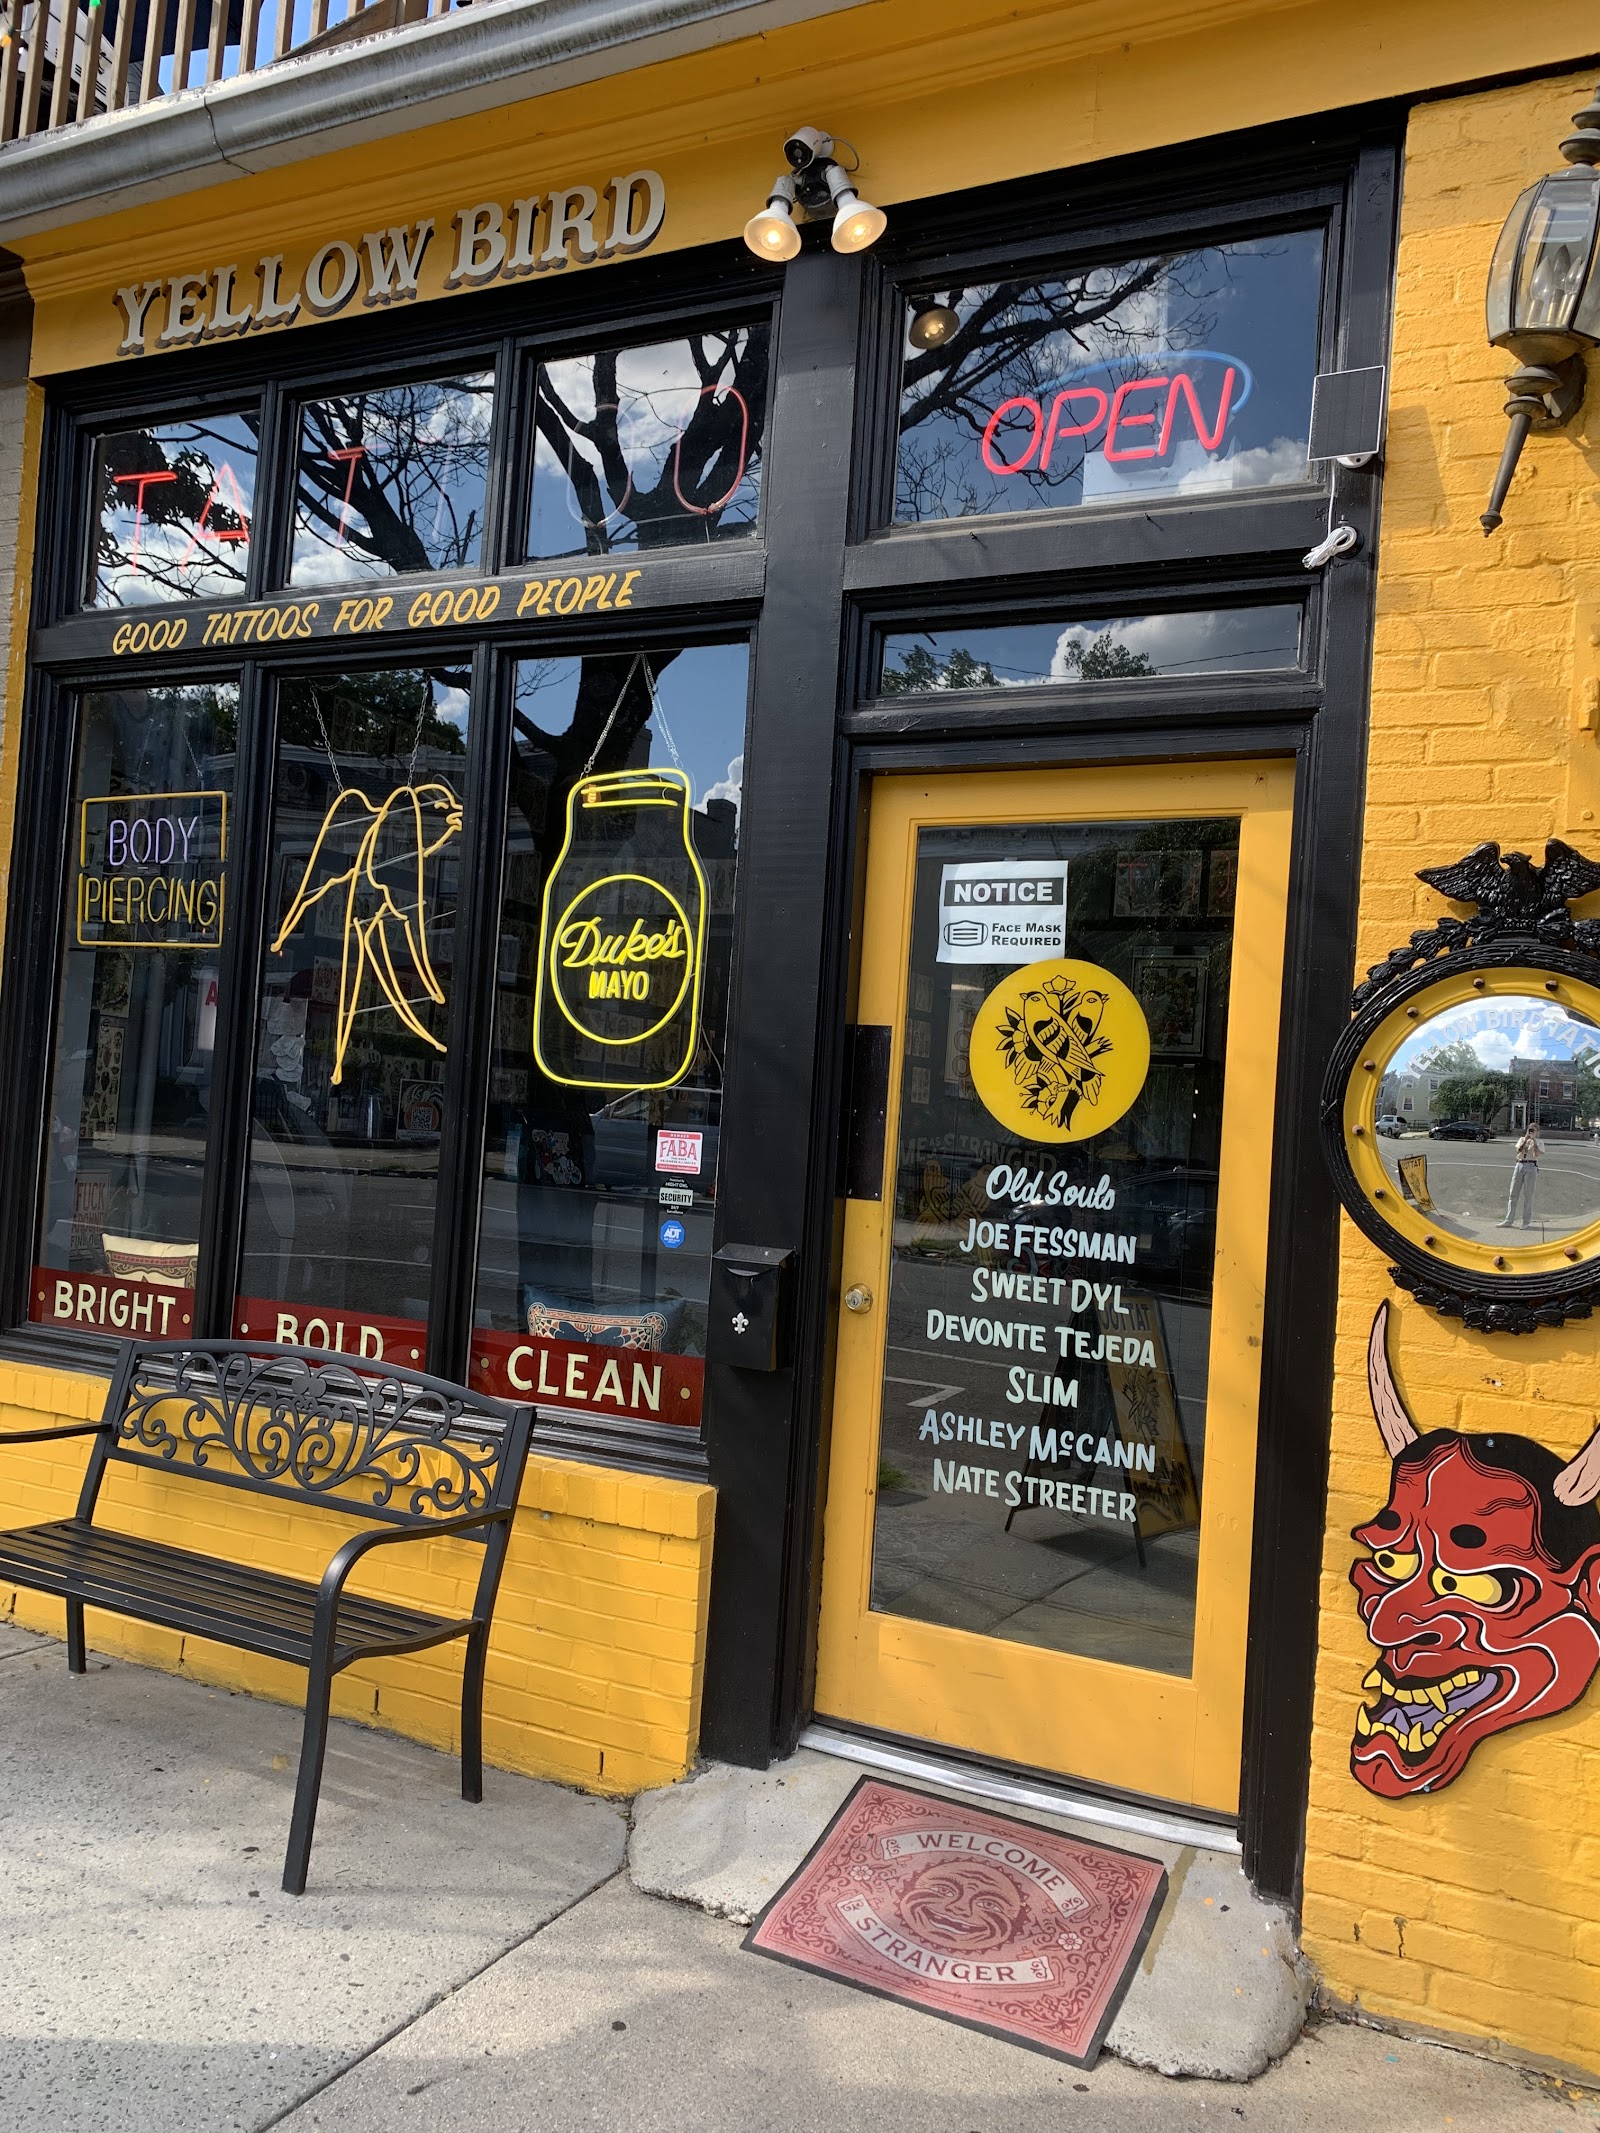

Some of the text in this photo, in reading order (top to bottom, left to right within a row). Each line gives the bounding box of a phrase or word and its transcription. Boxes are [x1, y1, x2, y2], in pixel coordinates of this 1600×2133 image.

[113, 169, 667, 355] YELLOW BIRD
[982, 368, 1236, 475] OPEN
[112, 570, 642, 655] GOOD TATTOOS FOR GOOD PEOPLE
[109, 816, 198, 867] BODY
[84, 876, 217, 927] PIERCING
[953, 882, 1053, 903] NOTICE
[560, 917, 686, 967] Duke's
[991, 935, 1061, 946] REQUIRED
[992, 922, 1062, 933] FACE MASK
[589, 970, 649, 1000] MAYO
[1400, 1013, 1478, 1079] YELLOW
[1485, 1008, 1545, 1032] BIRD
[659, 1140, 698, 1160] FABA
[661, 1192, 692, 1203] SECURITY
[985, 1164, 1116, 1211] Old Souls
[664, 1228, 682, 1239] ADT
[959, 1218, 1137, 1264] JOE FESSMAN
[53, 1280, 177, 1335] BRIGHT
[970, 1267, 1130, 1315] SWEET DYL
[276, 1311, 385, 1361] BOLD
[926, 1309, 1157, 1368] DEVONTE TEJEDA
[507, 1346, 664, 1411] CLEAN
[1006, 1366, 1078, 1408] SLIM
[919, 1409, 1026, 1450] ASHLEY
[933, 1458, 999, 1498] NATE
[1004, 1471, 1137, 1523] STREETER
[916, 1832, 1066, 1893] WELCOME
[857, 1915, 1017, 1982] STRANGER
